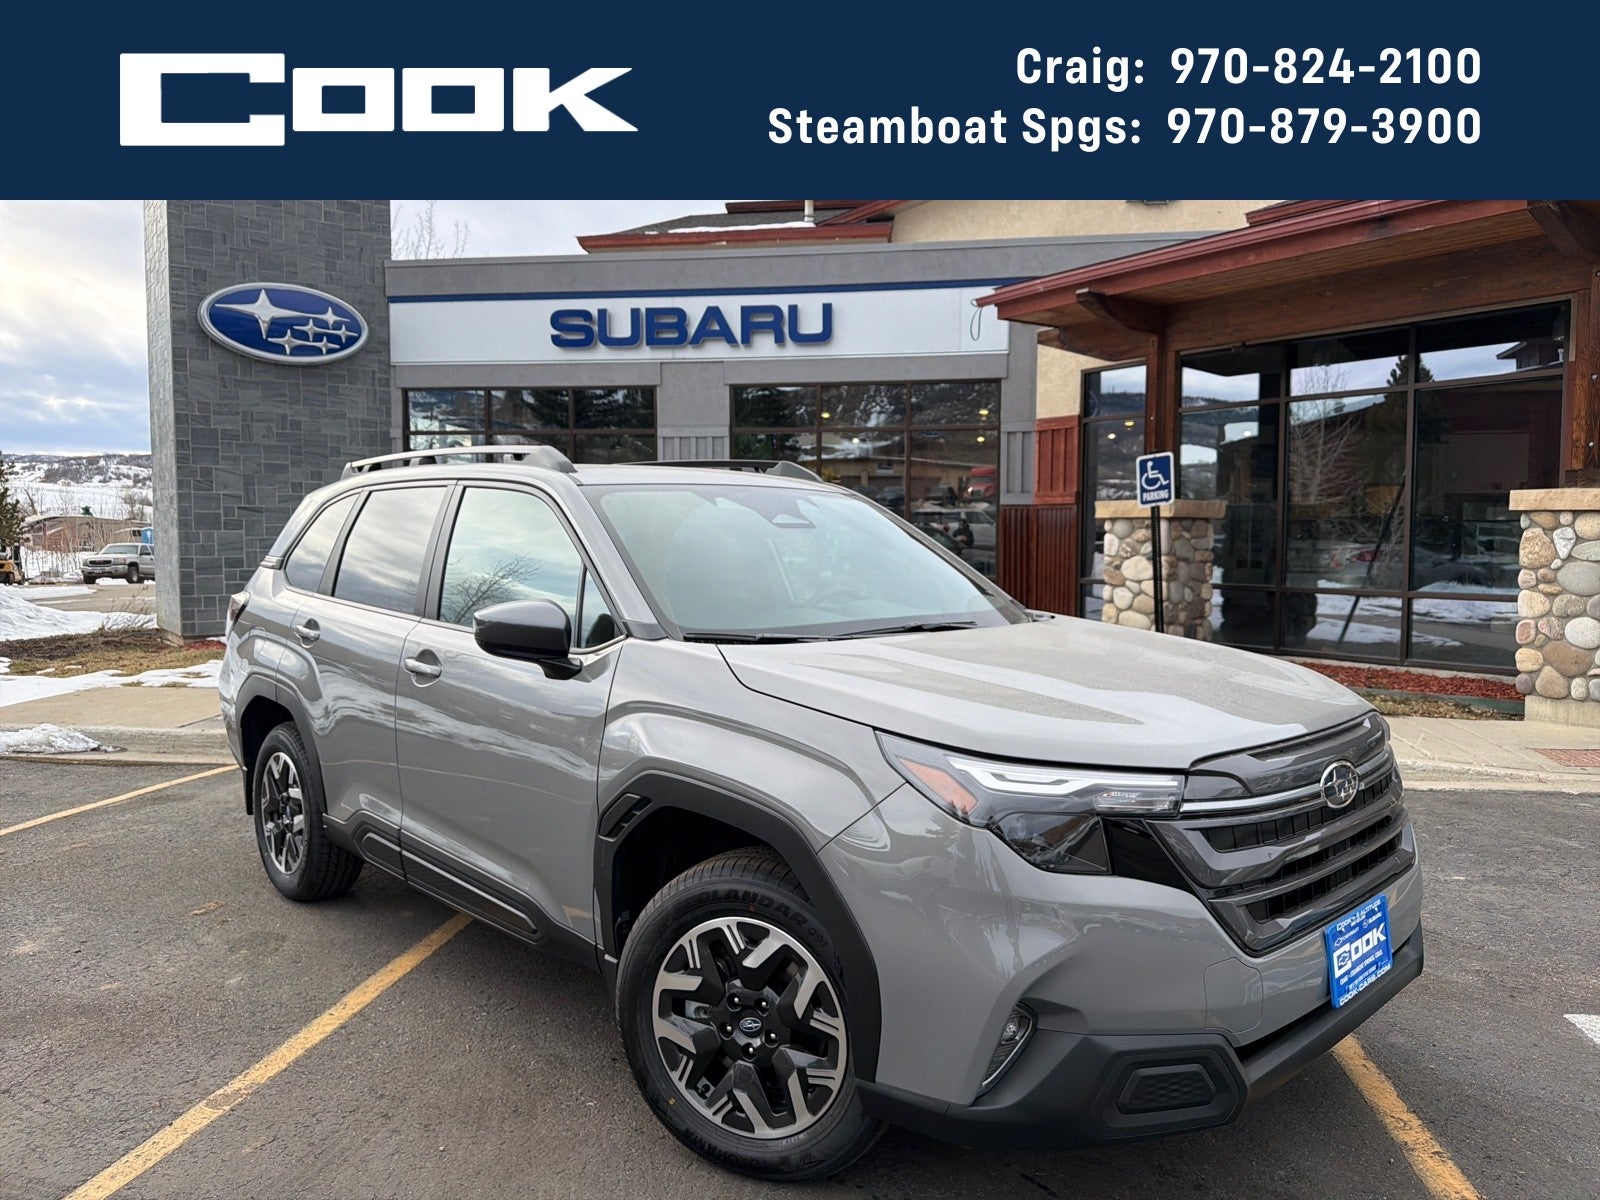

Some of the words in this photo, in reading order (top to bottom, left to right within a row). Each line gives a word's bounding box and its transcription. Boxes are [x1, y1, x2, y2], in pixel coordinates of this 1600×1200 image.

[550, 303, 834, 349] SUBARU
[1142, 489, 1169, 502] PARKING
[1332, 921, 1387, 979] COOK
